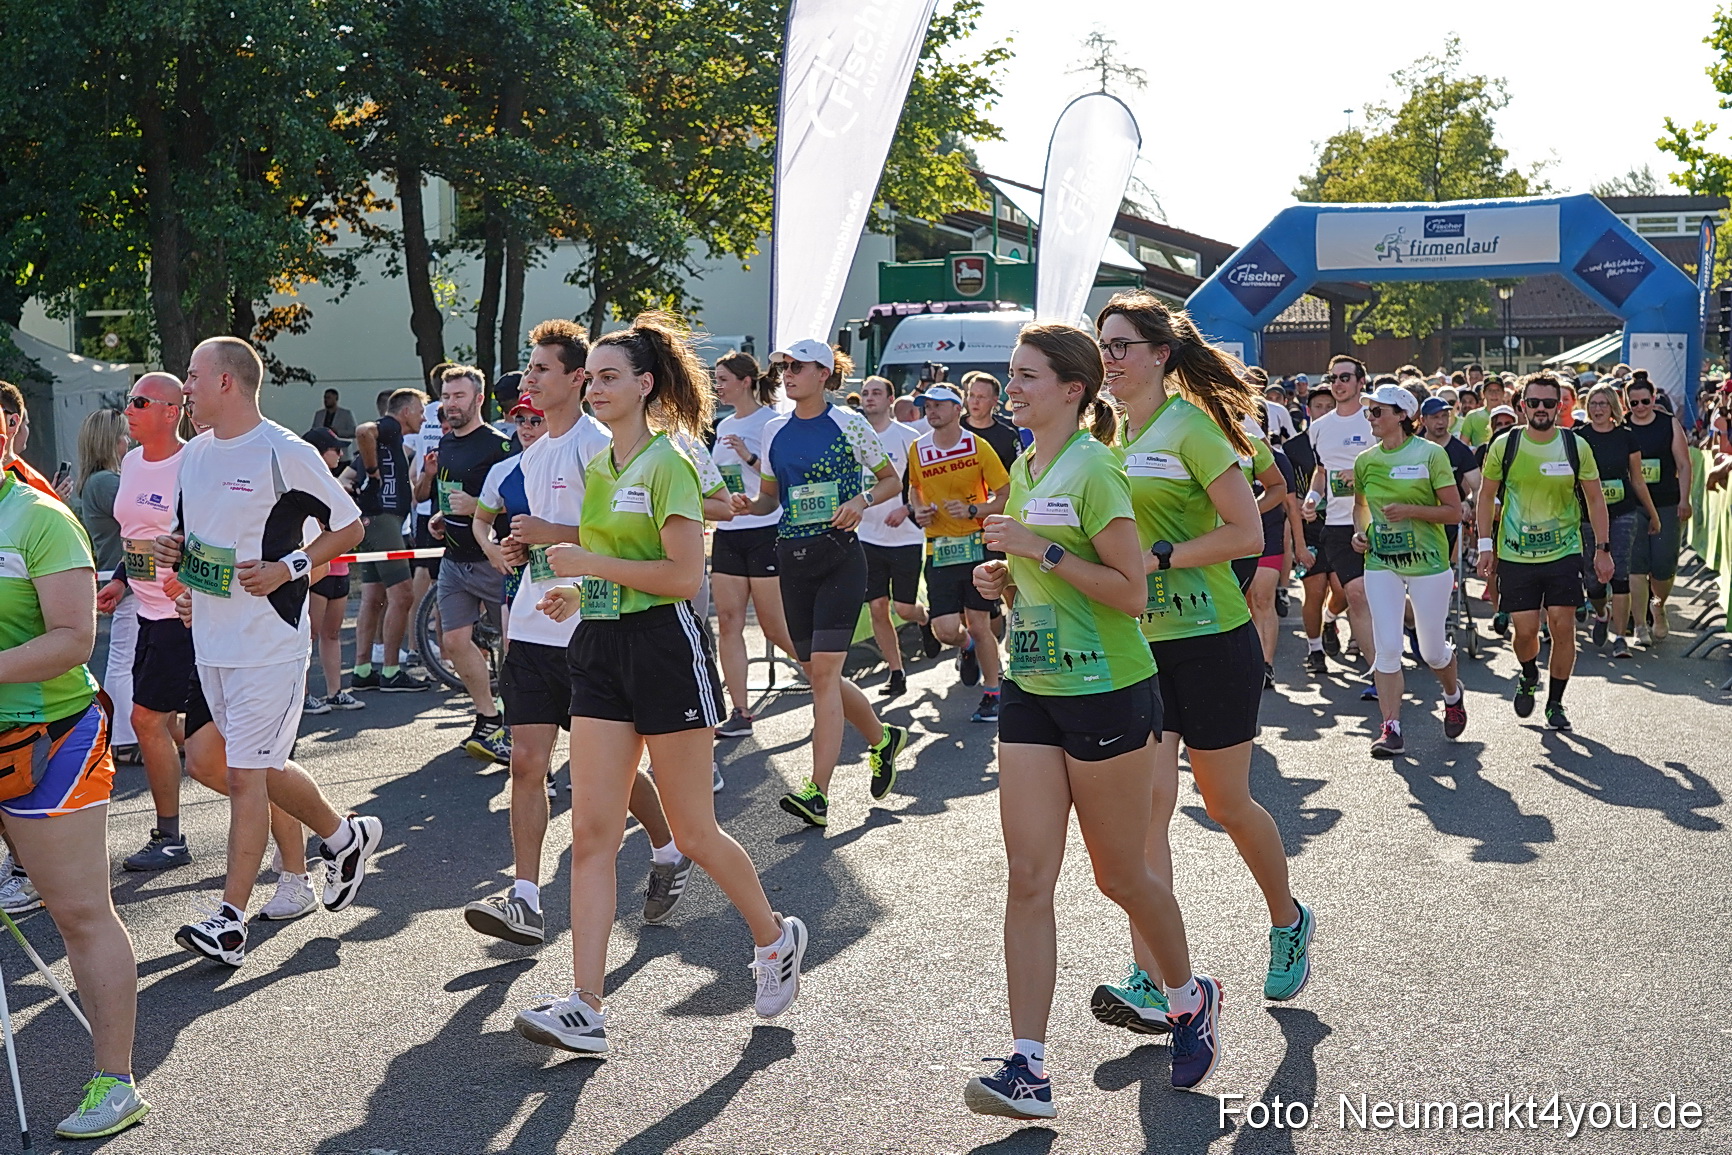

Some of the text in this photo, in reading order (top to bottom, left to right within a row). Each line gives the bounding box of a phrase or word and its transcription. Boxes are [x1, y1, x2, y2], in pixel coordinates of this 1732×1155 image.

[1409, 236, 1500, 256] firmenlauf
[1237, 269, 1286, 282] Fischer
[922, 458, 980, 479] MAX BÖGL
[801, 496, 826, 511] 686
[1381, 533, 1403, 544] 925
[1528, 532, 1551, 543] 938
[127, 553, 144, 568] 533
[938, 544, 965, 558] 1605
[187, 553, 220, 580] 1961
[221, 568, 231, 591] 2022
[1154, 576, 1166, 603] 2022
[587, 580, 608, 600] 924
[1014, 630, 1040, 653] 922
[1046, 632, 1057, 664] 2022
[1025, 654, 1046, 664] Regina
